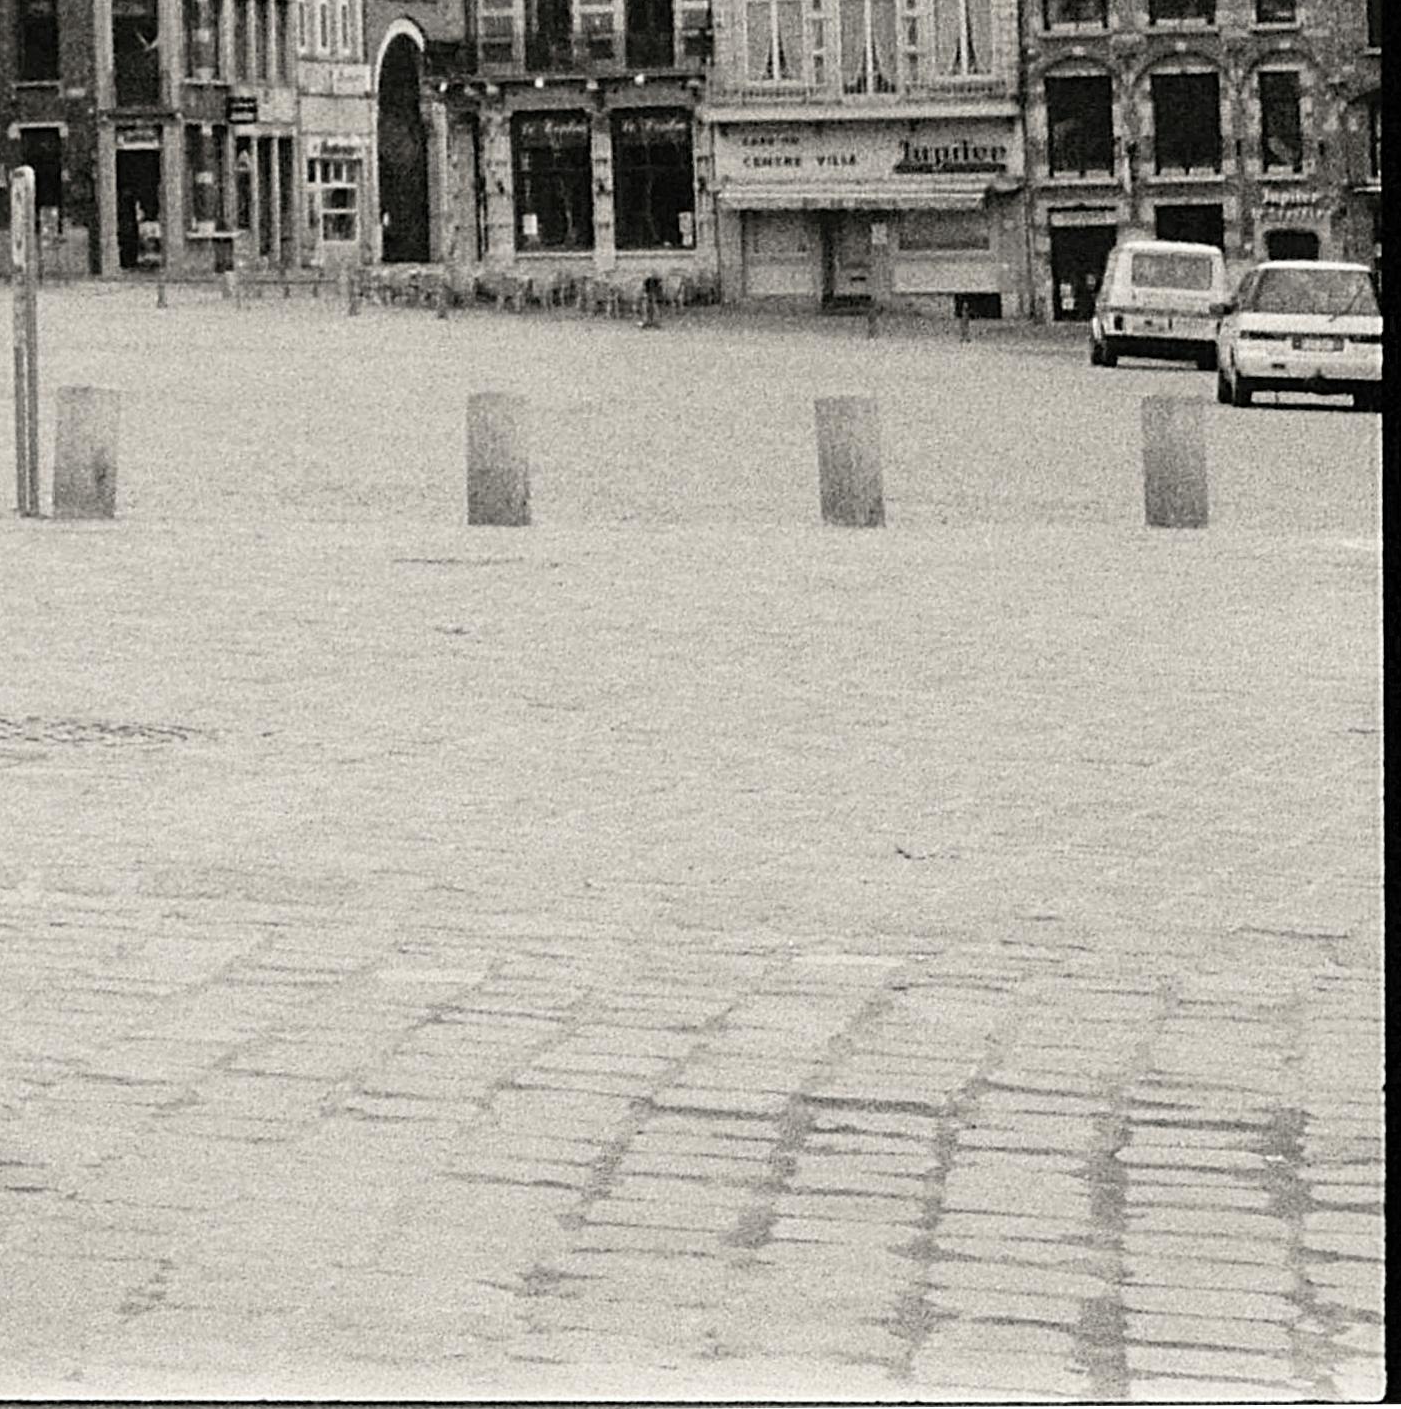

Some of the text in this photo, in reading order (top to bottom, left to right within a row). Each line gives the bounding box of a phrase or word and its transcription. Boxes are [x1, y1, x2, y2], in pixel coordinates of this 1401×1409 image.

[743, 153, 856, 168] CENTRE VILLE
[898, 139, 1006, 167] Jupiler
